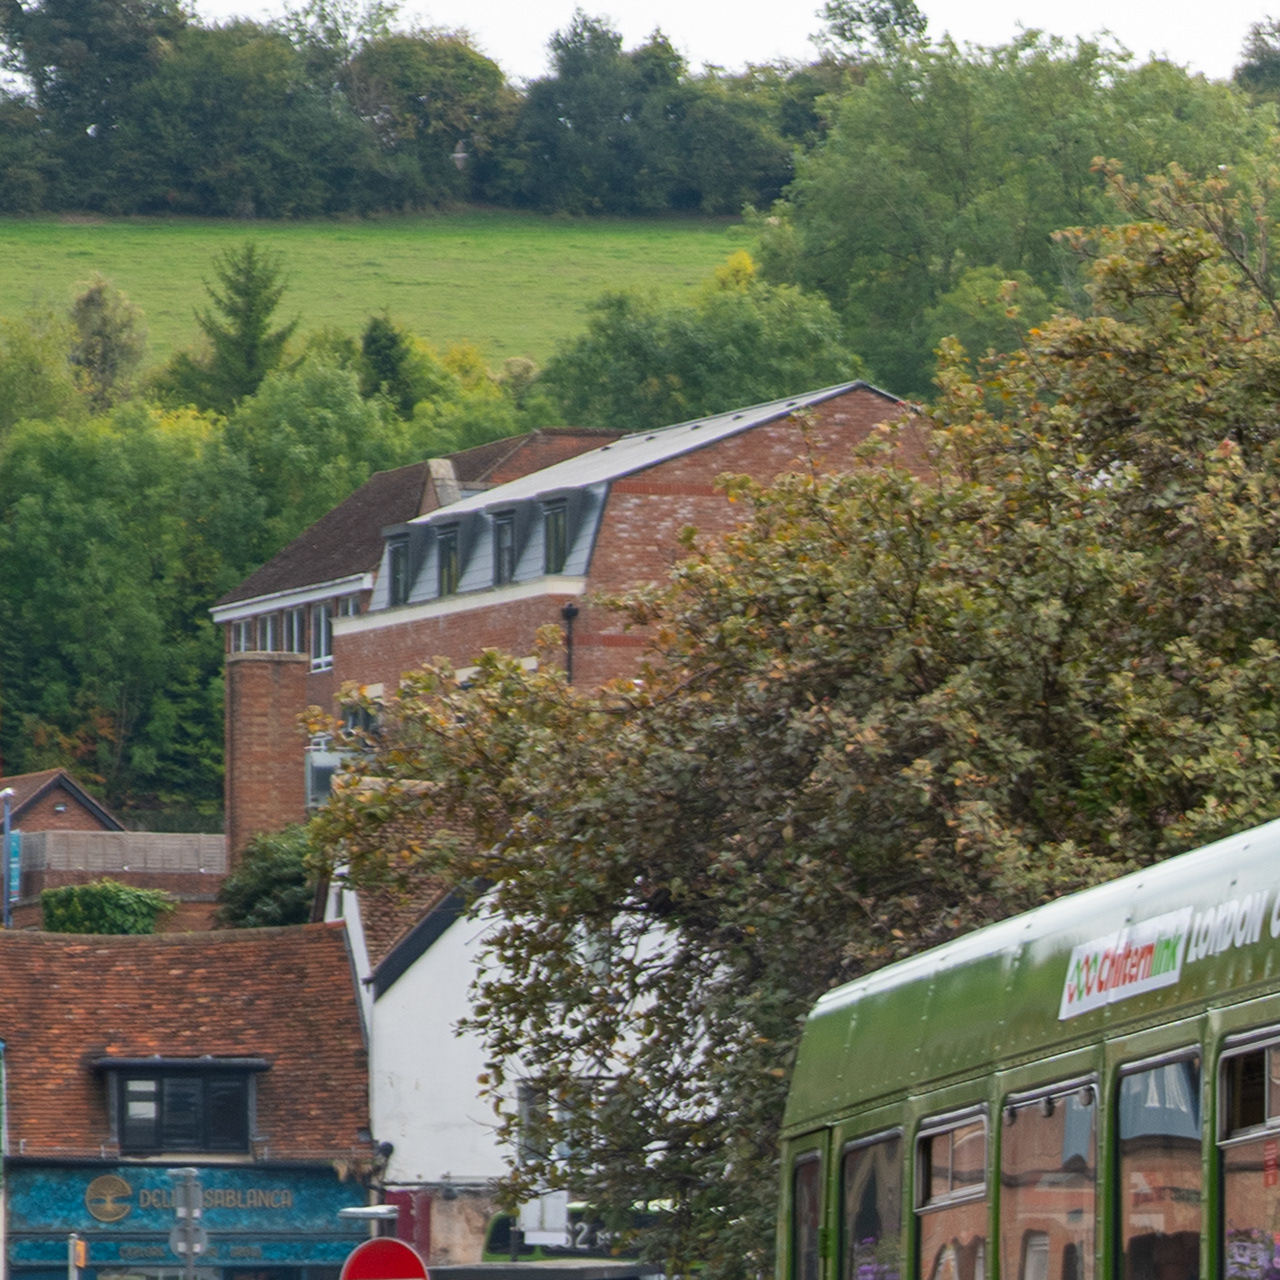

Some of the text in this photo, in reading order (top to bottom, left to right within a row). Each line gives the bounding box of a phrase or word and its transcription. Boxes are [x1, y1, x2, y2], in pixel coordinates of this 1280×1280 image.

[1186, 890, 1269, 963] LONDON
[1097, 930, 1184, 993] Chilternlink
[203, 1189, 293, 1208] SABLANCA
